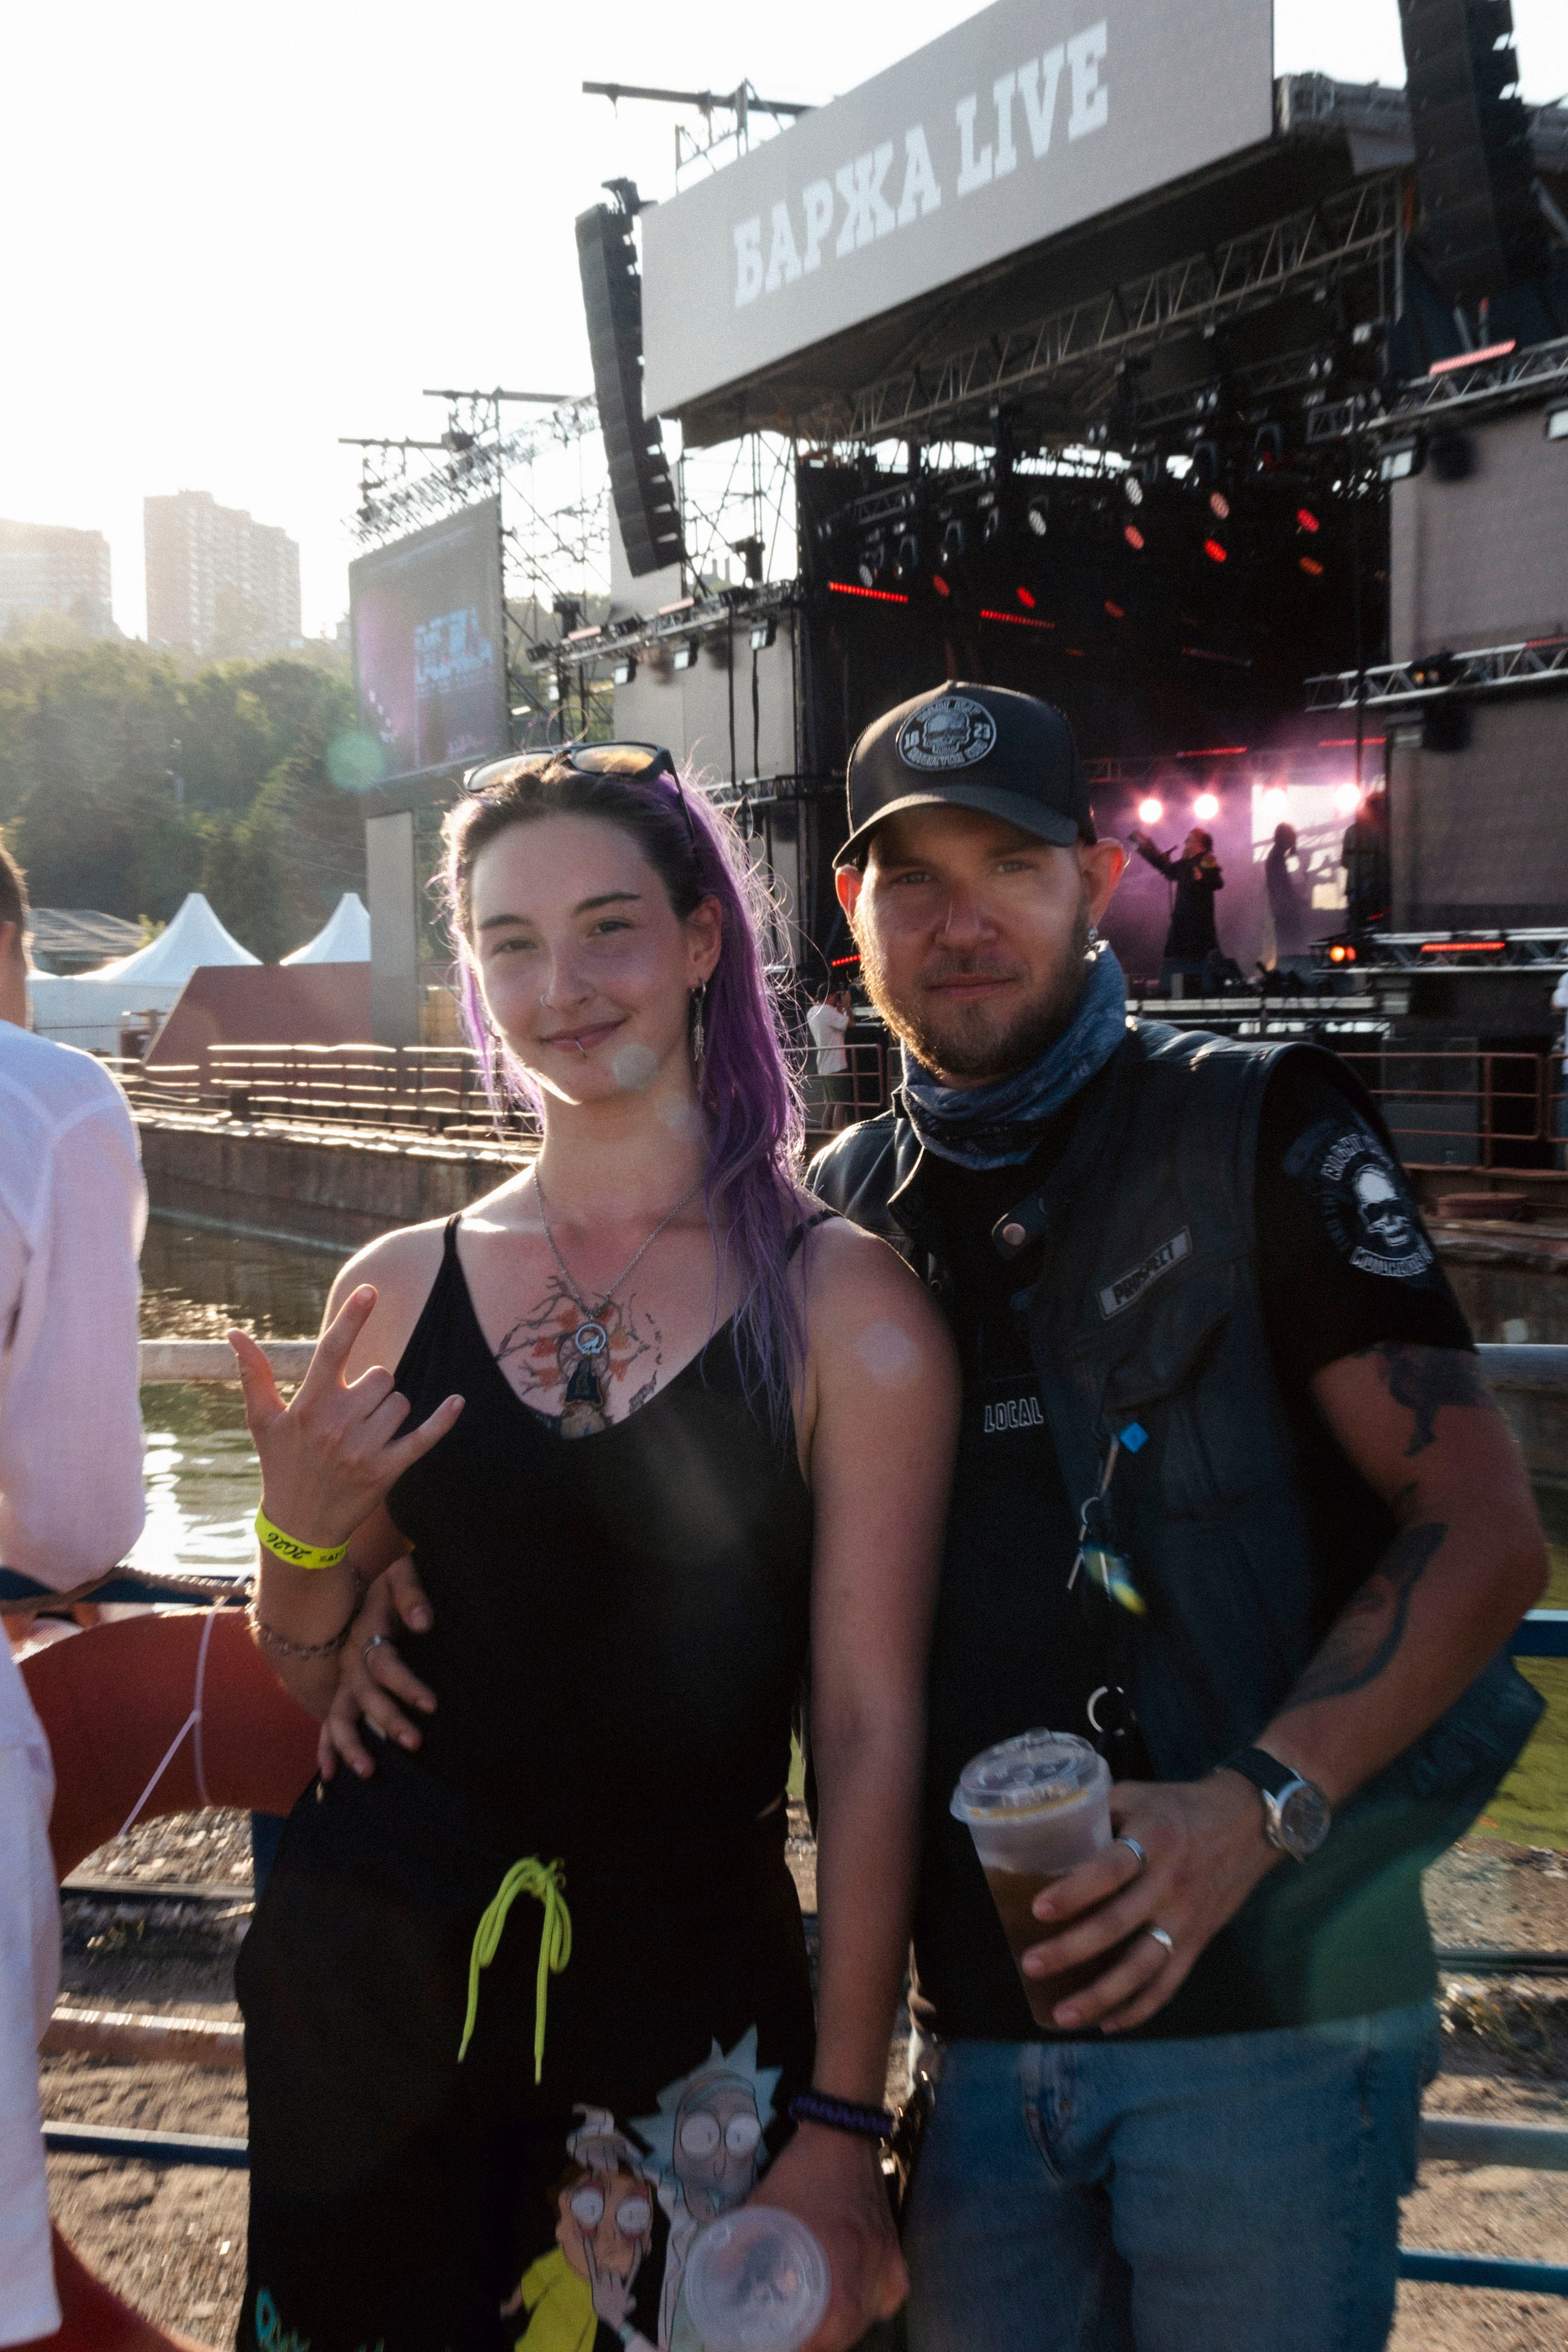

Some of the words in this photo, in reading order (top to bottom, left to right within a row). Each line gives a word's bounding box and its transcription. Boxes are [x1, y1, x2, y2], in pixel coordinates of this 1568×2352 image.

[734, 123, 941, 307] БАРЖА
[956, 20, 1107, 198] LIVE
[984, 1397, 1043, 1433] LOCAL
[266, 1532, 312, 1559] 2026
